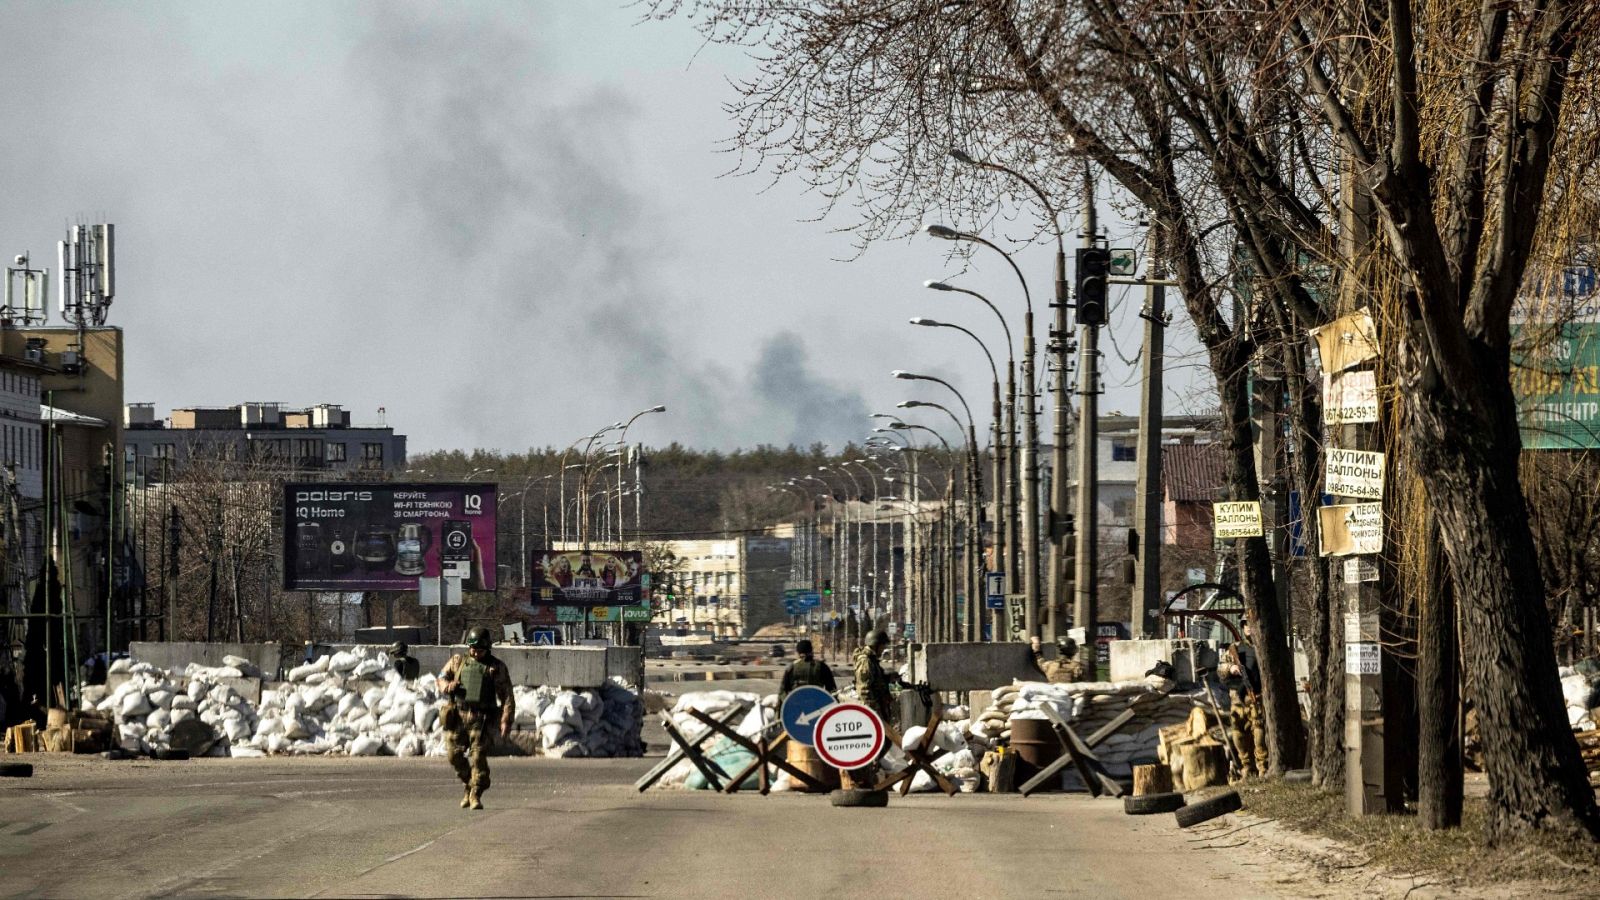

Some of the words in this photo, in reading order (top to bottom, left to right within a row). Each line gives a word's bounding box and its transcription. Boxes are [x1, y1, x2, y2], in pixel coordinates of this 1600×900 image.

[1332, 451, 1376, 466] КУПИМ
[1328, 464, 1382, 480] БАЛЛОНЫ
[296, 490, 373, 503] polaris
[393, 491, 426, 499] КЕРУЙТЕ
[414, 501, 452, 509] ТЕХНІКОЮ
[465, 494, 482, 510] IQ
[1220, 503, 1254, 512] КУПИМ
[296, 507, 308, 518] IQ
[311, 507, 345, 517] Home
[1356, 504, 1381, 515] ПЕСОК
[1216, 514, 1260, 523] БАЛЛОНЫ
[835, 721, 863, 733] STOP
[828, 742, 872, 751] КОНТРОЛЬ
